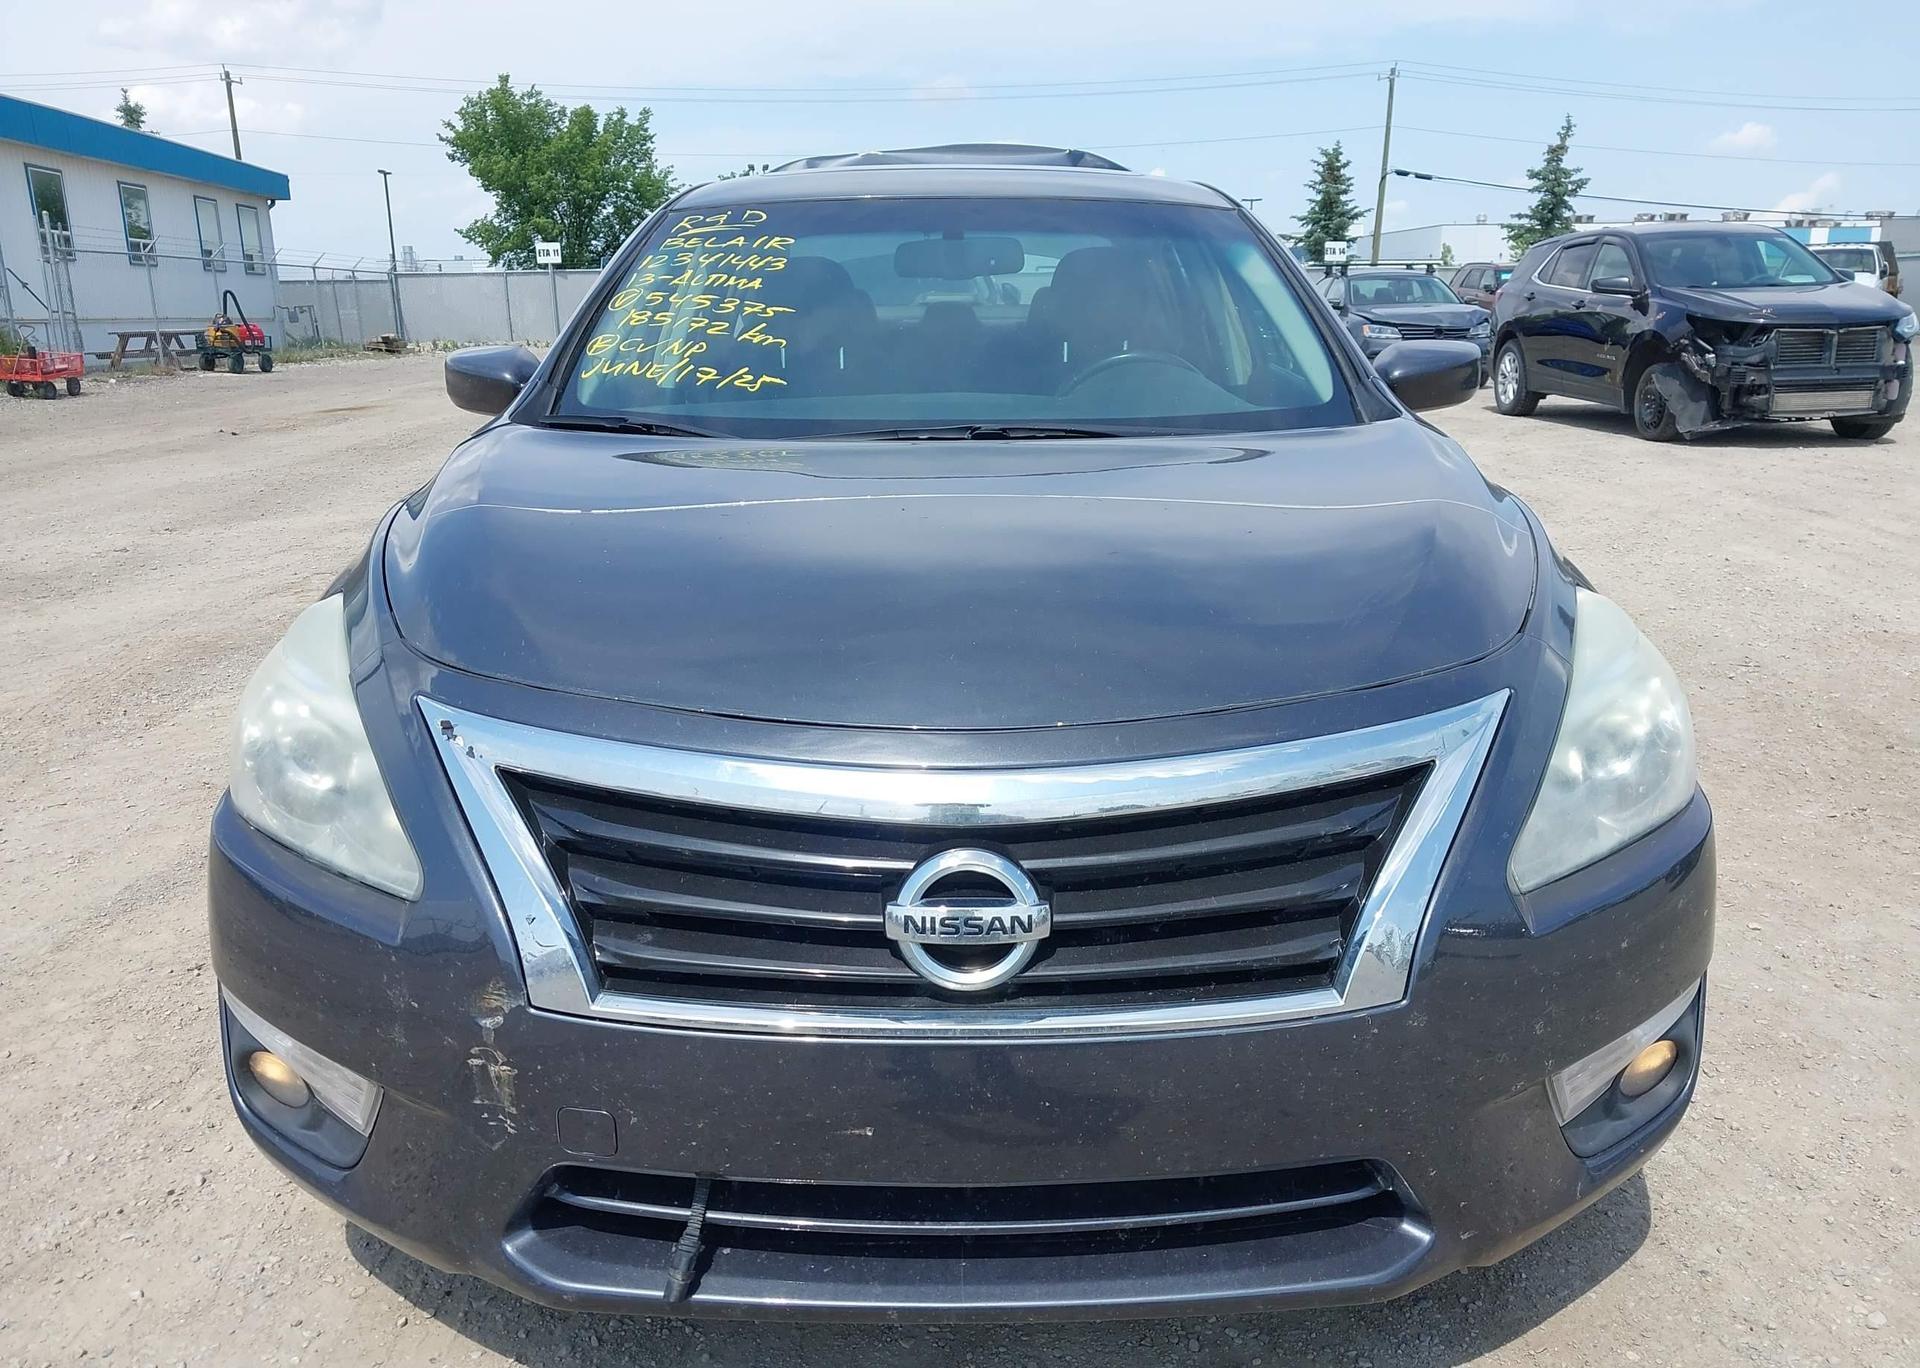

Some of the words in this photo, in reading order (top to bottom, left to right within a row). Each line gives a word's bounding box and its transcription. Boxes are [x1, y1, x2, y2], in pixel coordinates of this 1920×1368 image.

[538, 248, 551, 257] ETA
[553, 248, 560, 257] 11
[903, 914, 1033, 936] NISSAN
